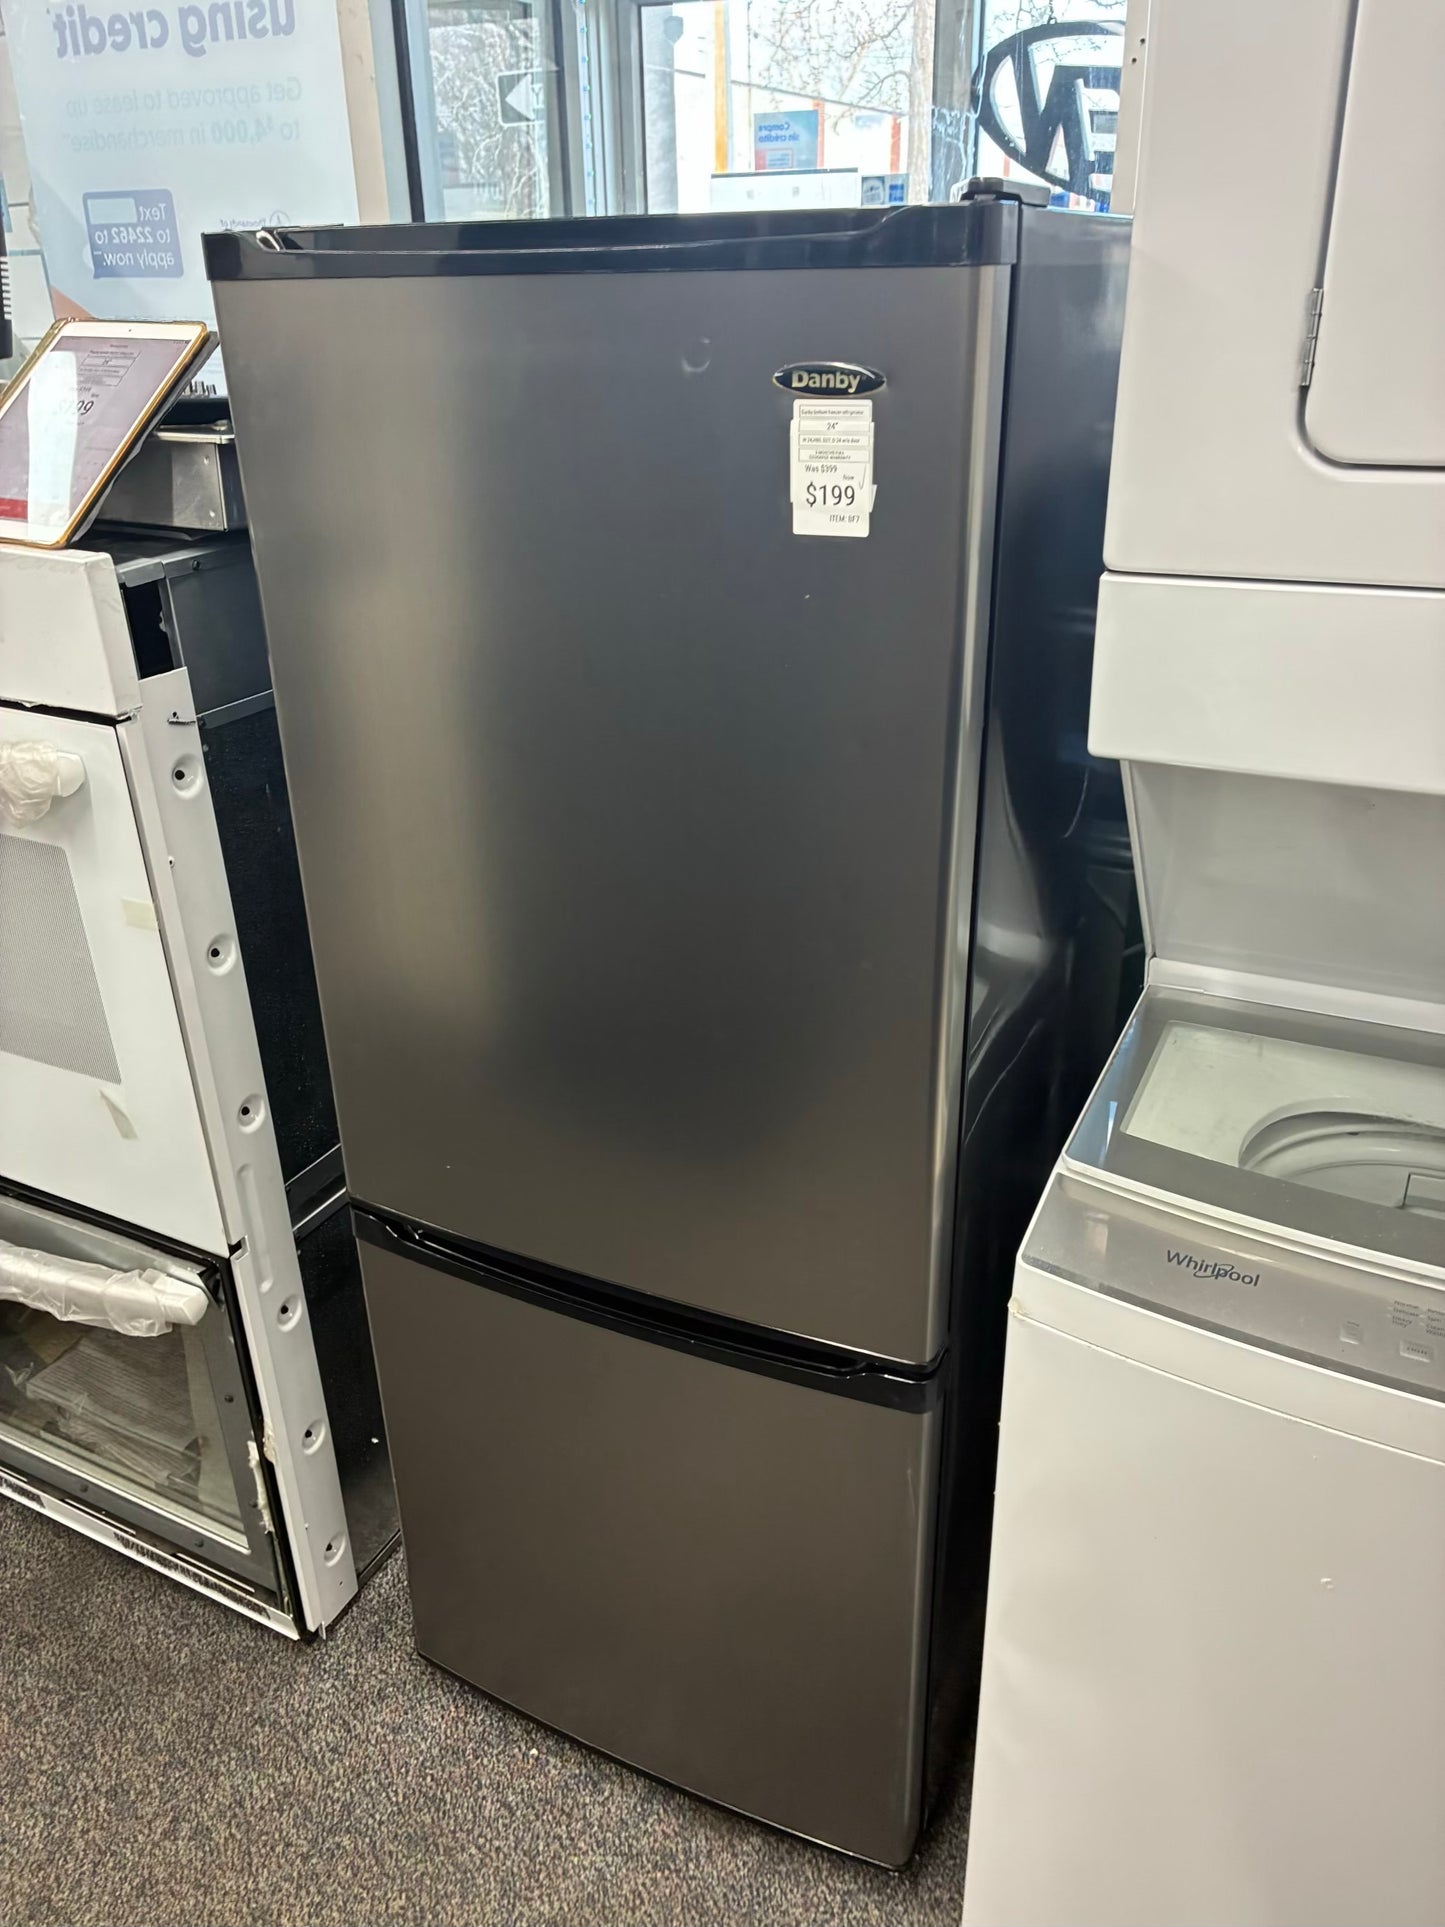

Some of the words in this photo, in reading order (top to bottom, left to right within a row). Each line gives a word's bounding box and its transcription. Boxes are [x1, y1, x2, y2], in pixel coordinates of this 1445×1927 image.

[791, 370, 861, 394] Danby
[805, 464, 819, 473] Was
[820, 464, 838, 474] $399
[806, 481, 855, 508] $199
[1167, 1249, 1260, 1287] Whirlpool
